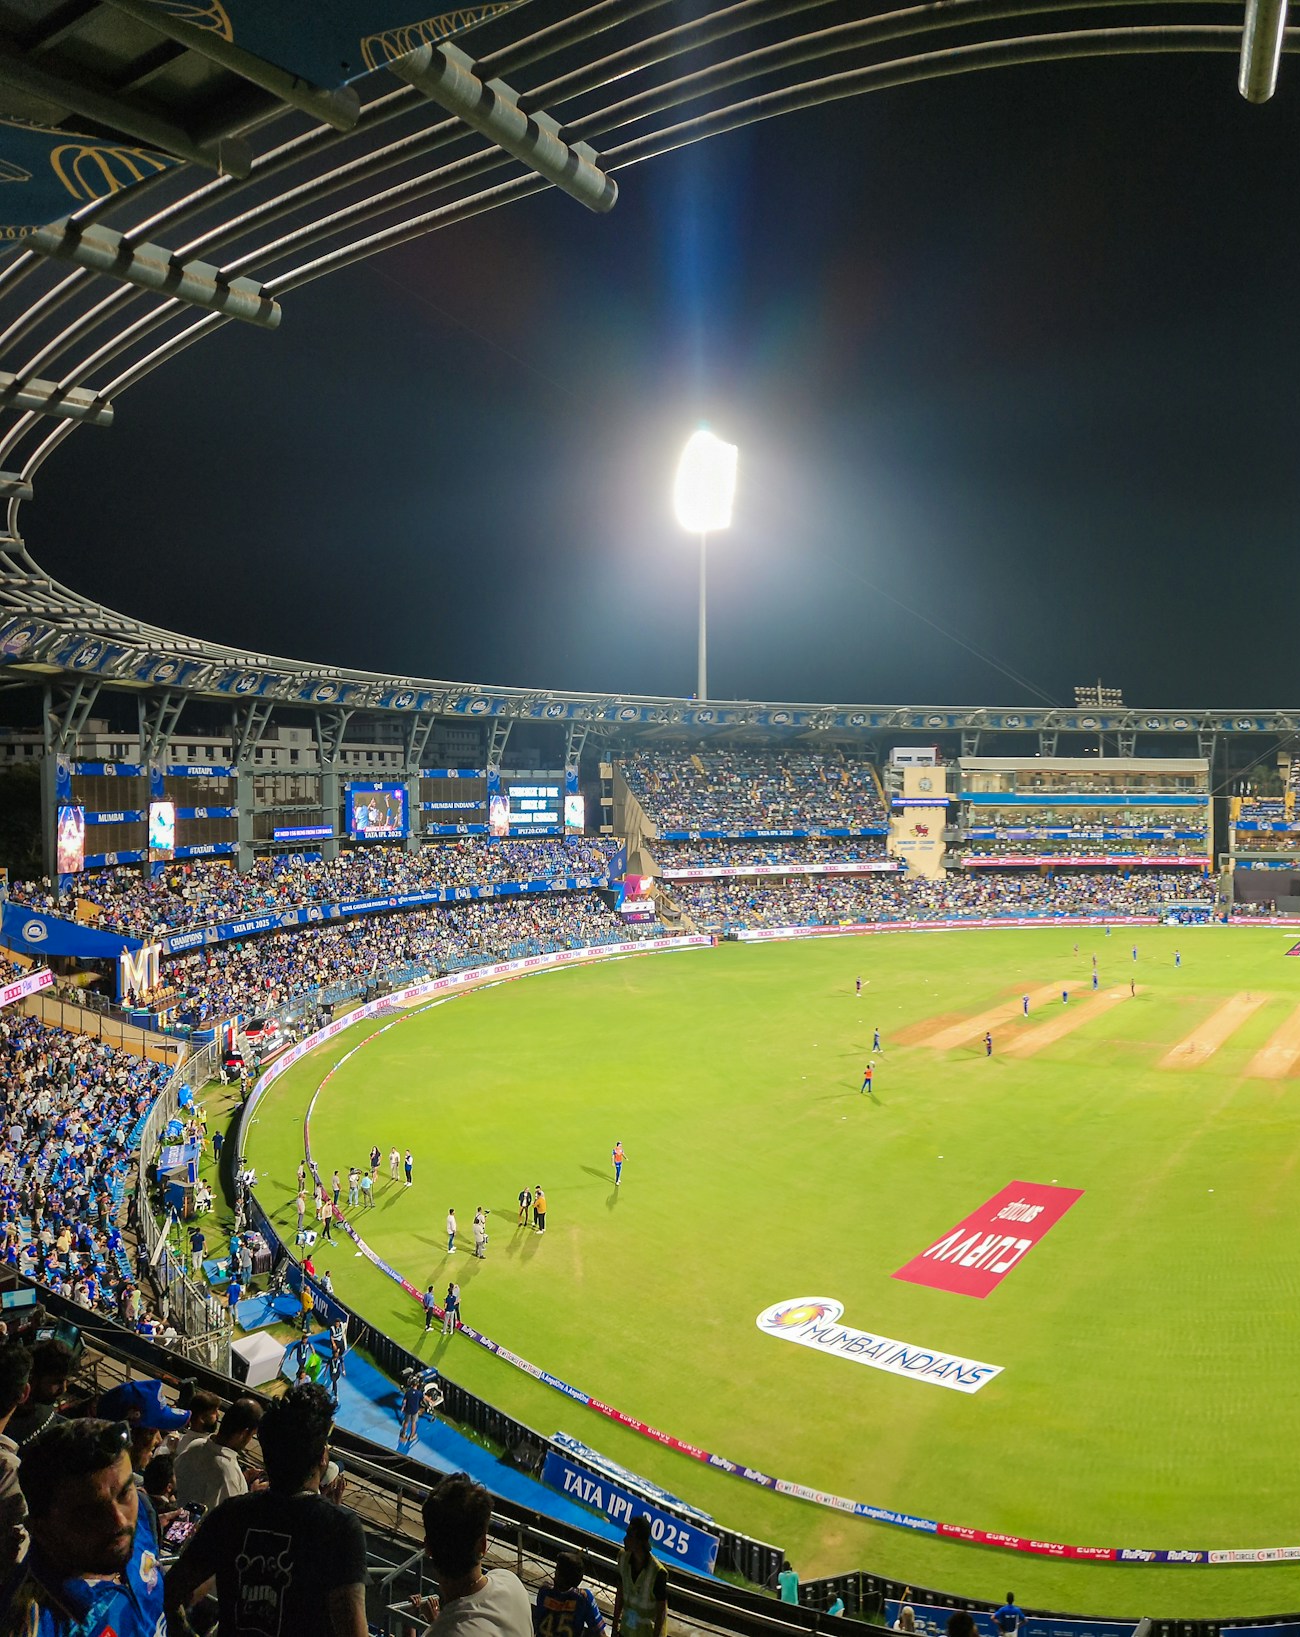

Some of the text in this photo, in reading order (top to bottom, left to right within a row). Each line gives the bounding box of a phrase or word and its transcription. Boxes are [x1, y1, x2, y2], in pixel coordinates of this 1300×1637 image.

[187, 766, 213, 775] #TATAIPL
[98, 813, 124, 823] MUMBAI
[189, 845, 215, 854] #TATAIPL
[232, 919, 270, 934] TATA IPL 2025
[171, 932, 203, 947] CHAMPIONS
[922, 1228, 1032, 1273] CURVV
[800, 1324, 994, 1384] MUMBAI INDIANS
[593, 1400, 613, 1413] CURVV
[619, 1413, 641, 1428] CURVV
[648, 1427, 670, 1442] CURVV
[678, 1441, 702, 1455] CURVV
[710, 1454, 733, 1471] RuPay
[744, 1468, 767, 1485] RuPay
[564, 1469, 602, 1508] TATA
[607, 1494, 633, 1524] IPL
[863, 1506, 895, 1522] AngelOne
[903, 1516, 937, 1531] AngelOne
[942, 1524, 975, 1535] CURVV
[986, 1533, 1019, 1543] CURVV
[1030, 1541, 1065, 1550] CURVV
[1076, 1547, 1111, 1555] CURVV
[1121, 1549, 1151, 1562] RuPay
[1167, 1550, 1199, 1563] RuPay
